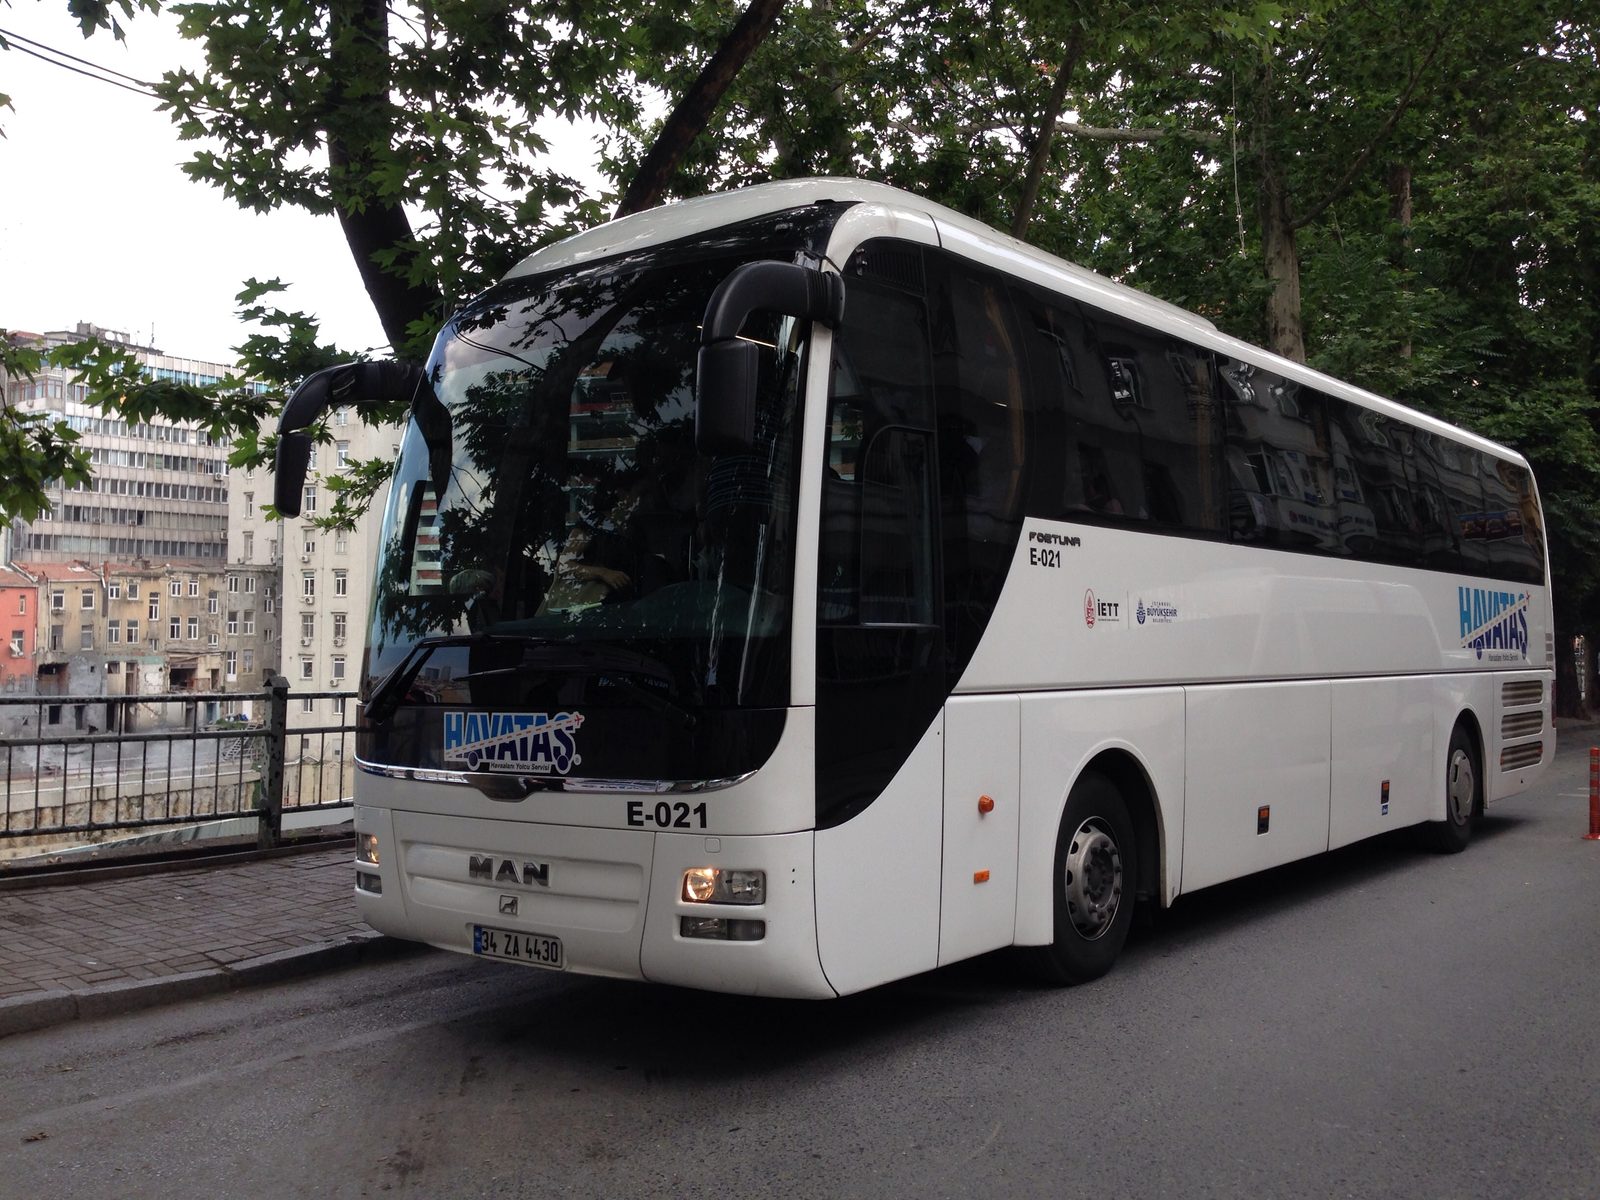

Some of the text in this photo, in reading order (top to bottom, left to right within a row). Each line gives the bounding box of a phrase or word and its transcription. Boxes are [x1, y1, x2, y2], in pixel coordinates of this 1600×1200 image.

[1030, 547, 1061, 568] E-021
[627, 801, 707, 829] E-021
[469, 855, 550, 888] MAN
[481, 931, 558, 963] 34 ZA 4430
